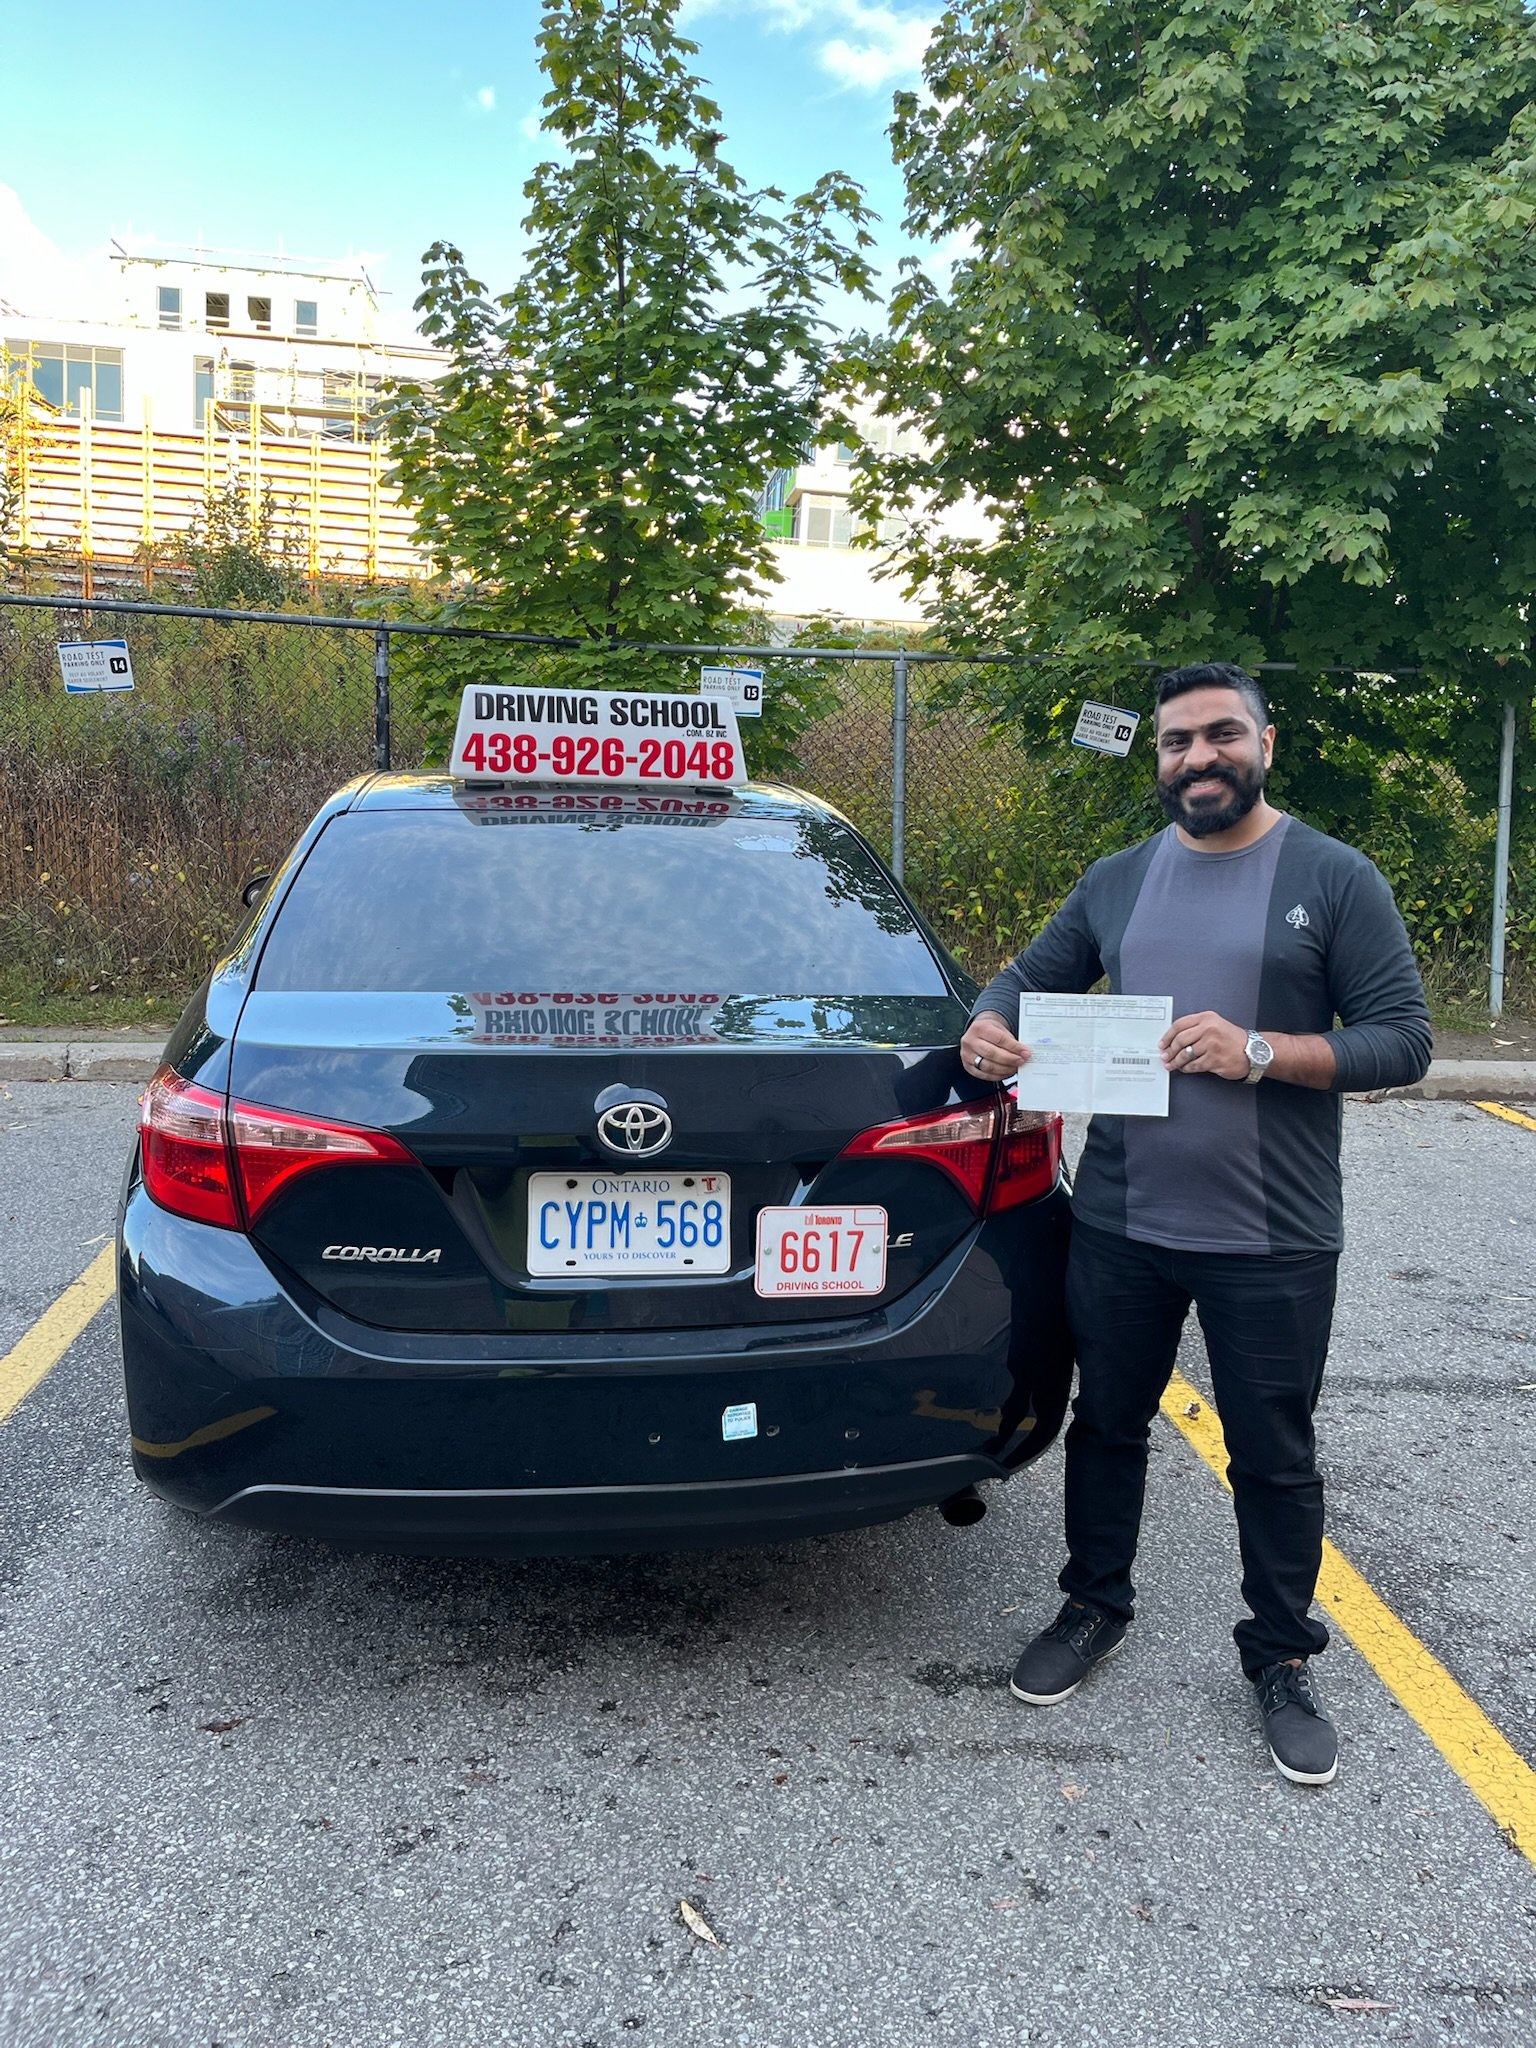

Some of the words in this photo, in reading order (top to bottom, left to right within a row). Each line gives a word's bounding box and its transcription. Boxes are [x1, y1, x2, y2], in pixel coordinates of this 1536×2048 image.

[62, 653, 83, 661] ROAD
[86, 651, 104, 660] TEST
[112, 660, 125, 671] 14
[703, 676, 722, 684] ROAD
[725, 677, 741, 685] TEST
[746, 687, 757, 698] 15
[474, 692, 598, 725] DRIVING
[610, 698, 727, 729] SCHOOL
[1082, 709, 1101, 720] ROAD
[1102, 714, 1118, 725] TEST
[1081, 718, 1101, 728] PARKING
[706, 729, 714, 738] BZ
[716, 730, 728, 738] INC
[1118, 727, 1129, 739] 16
[462, 732, 734, 780] 438-926-2048
[592, 1178, 670, 1195] ONTARIO
[540, 1201, 630, 1249] CYPM
[656, 1200, 722, 1248] 568
[815, 1215, 842, 1226] TORONTO
[322, 1245, 441, 1263] COROLLA
[584, 1252, 613, 1260] YOURS
[617, 1252, 629, 1260] TO
[632, 1252, 676, 1260] DISCOVER
[780, 1230, 864, 1273] 6617
[776, 1281, 819, 1291] DRIVING
[822, 1280, 864, 1290] SCHOOL
